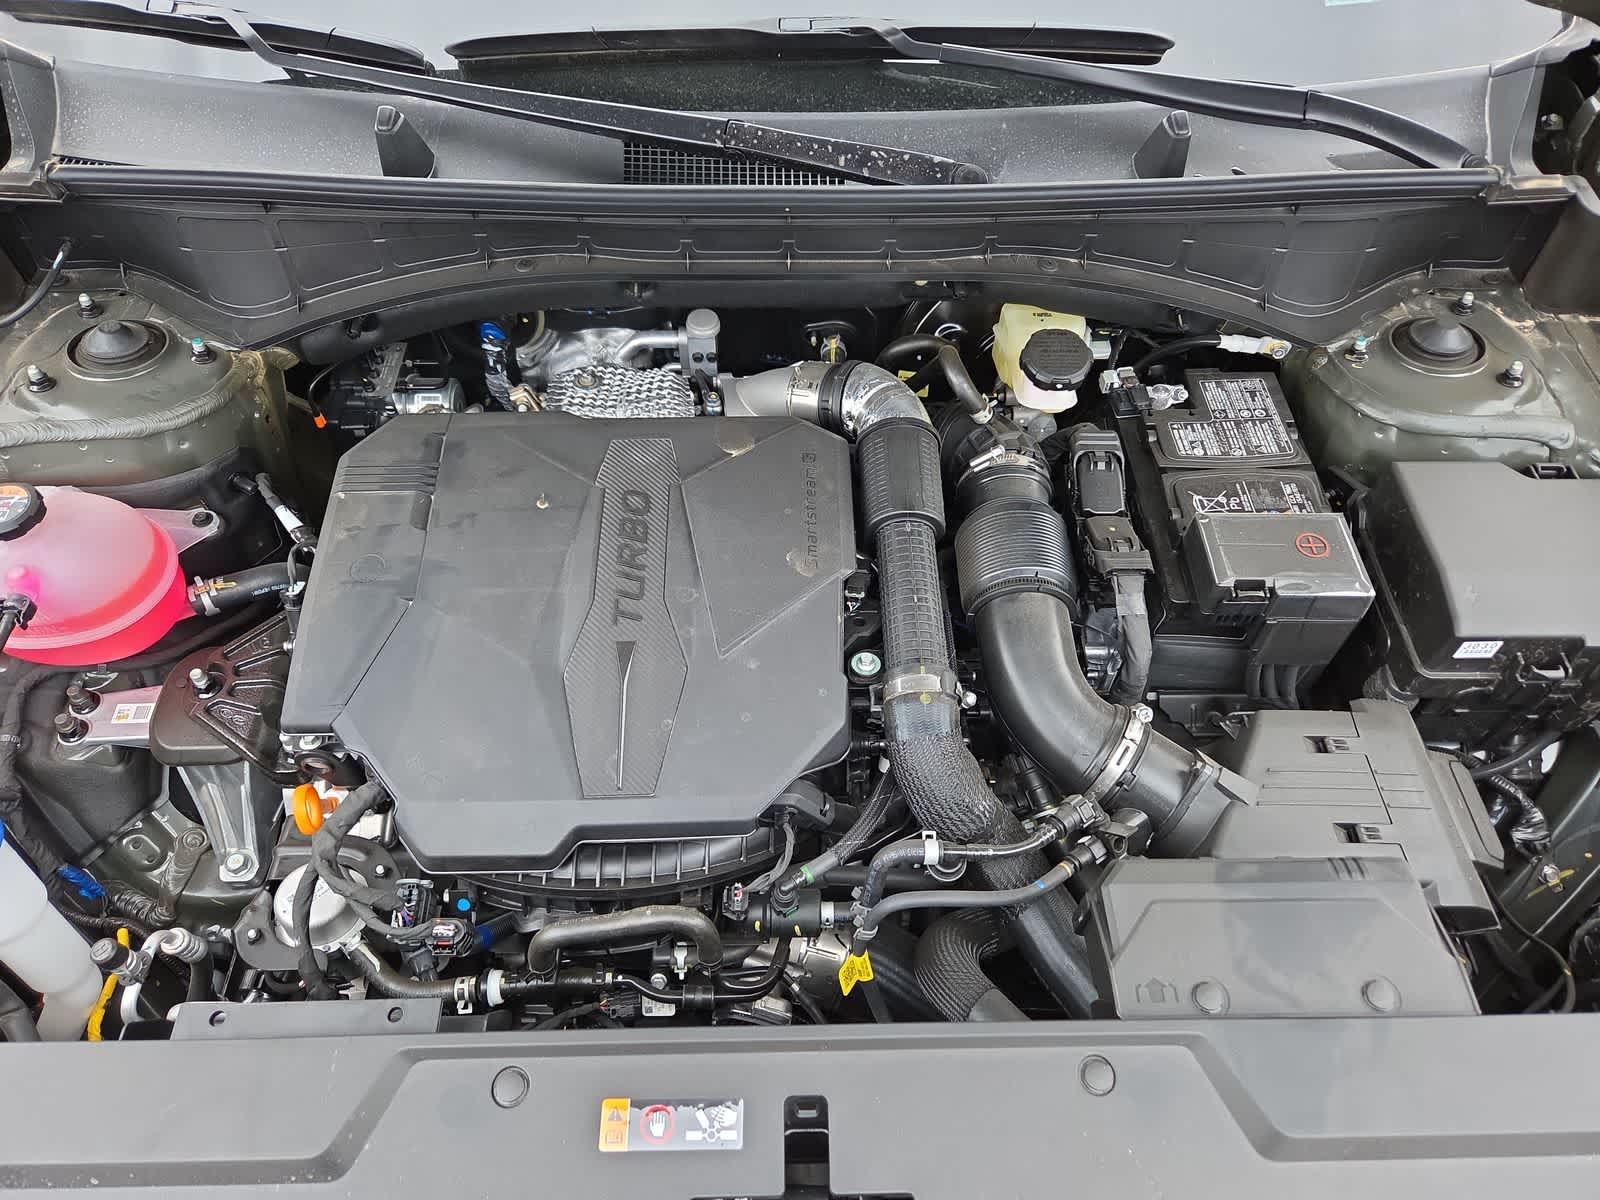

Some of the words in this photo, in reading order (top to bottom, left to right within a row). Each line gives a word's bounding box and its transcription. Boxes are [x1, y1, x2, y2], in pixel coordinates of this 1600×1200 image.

[806, 465, 818, 569] Smartstream
[1229, 496, 1242, 510] Pb
[614, 489, 649, 626] TURBO
